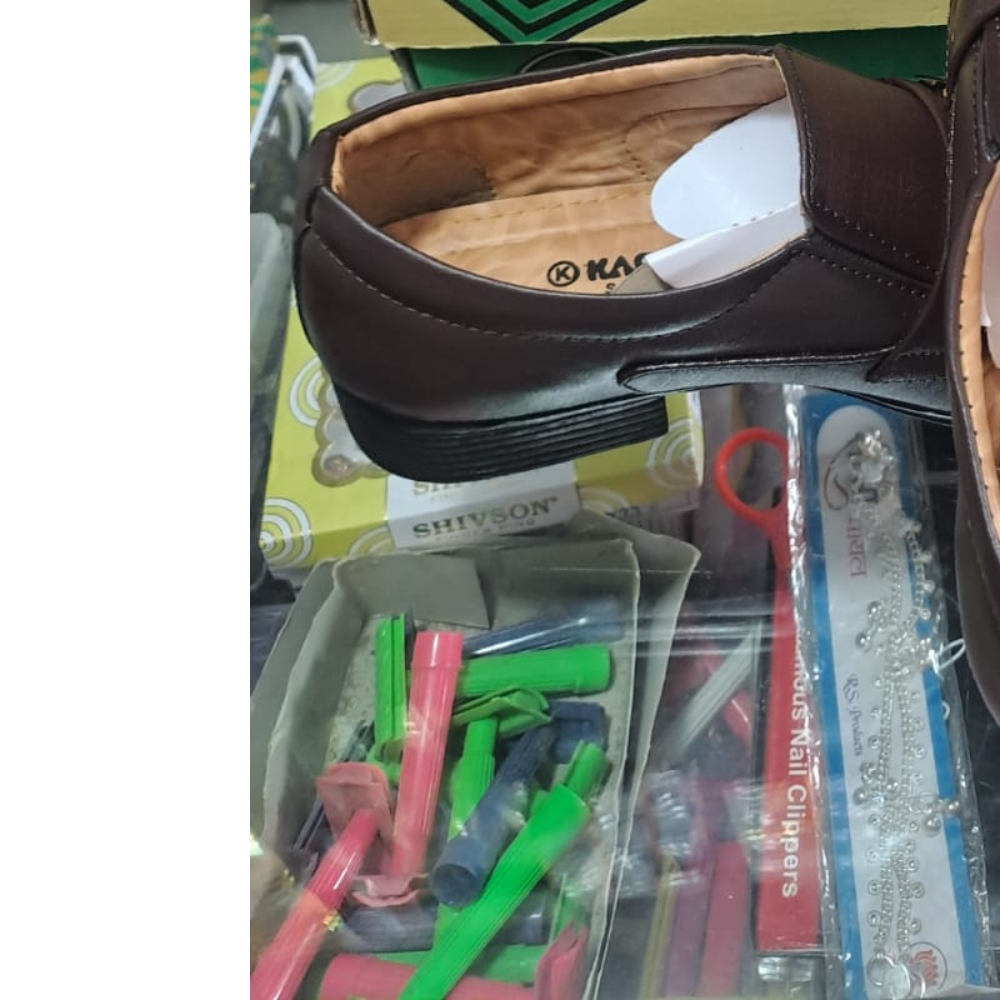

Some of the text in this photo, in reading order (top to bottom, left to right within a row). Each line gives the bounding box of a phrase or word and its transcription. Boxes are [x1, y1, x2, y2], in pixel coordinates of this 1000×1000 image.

[412, 498, 551, 539] SHIVSON
[788, 729, 810, 776] Nail
[781, 784, 807, 897] Clippers
